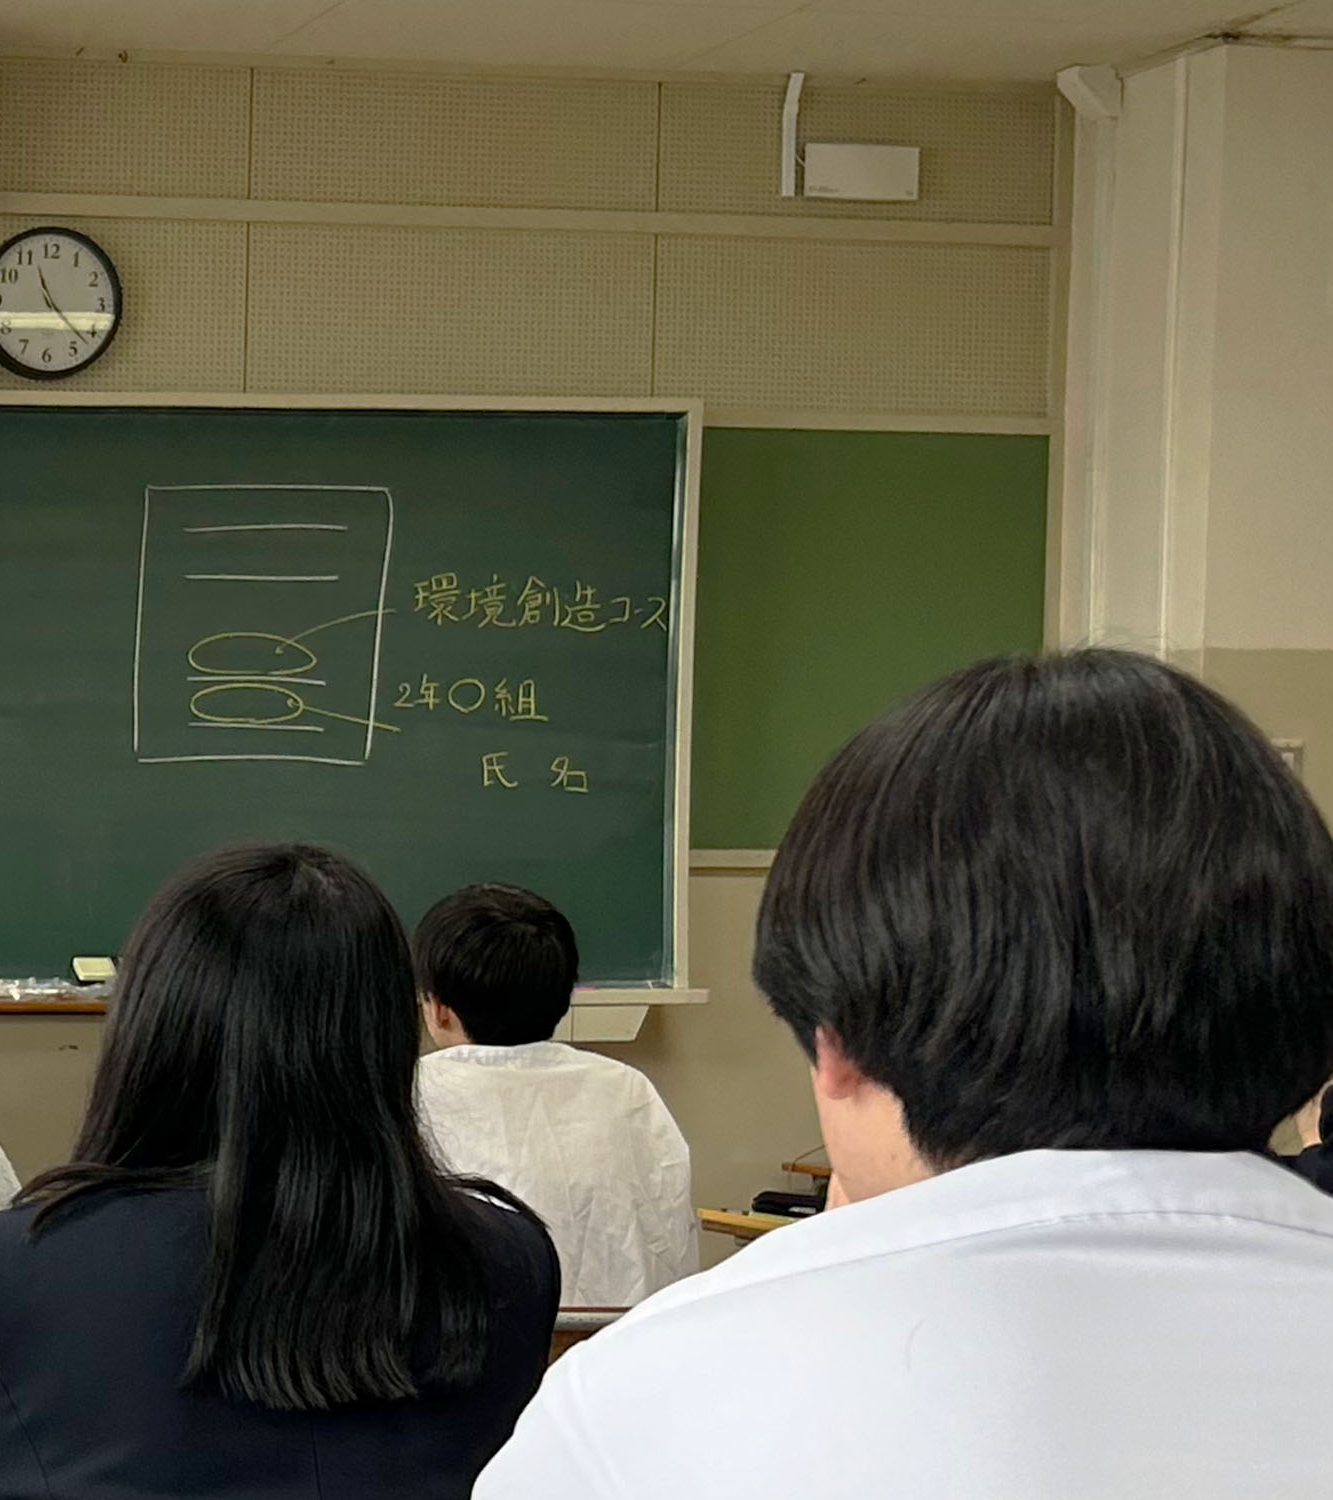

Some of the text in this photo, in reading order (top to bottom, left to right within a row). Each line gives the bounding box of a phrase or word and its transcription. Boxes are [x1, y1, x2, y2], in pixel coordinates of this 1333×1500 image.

[17, 249, 32, 265] 11
[43, 243, 59, 259] 12
[73, 251, 79, 267] 1
[0, 268, 18, 284] 10
[89, 271, 98, 287] 2
[97, 297, 105, 312] 3
[0, 319, 11, 334] 8
[87, 323, 98, 338] 4
[18, 339, 29, 354] 7
[68, 340, 78, 356] 5
[41, 347, 51, 363] 6
[413, 572, 668, 633] 環境創造コース
